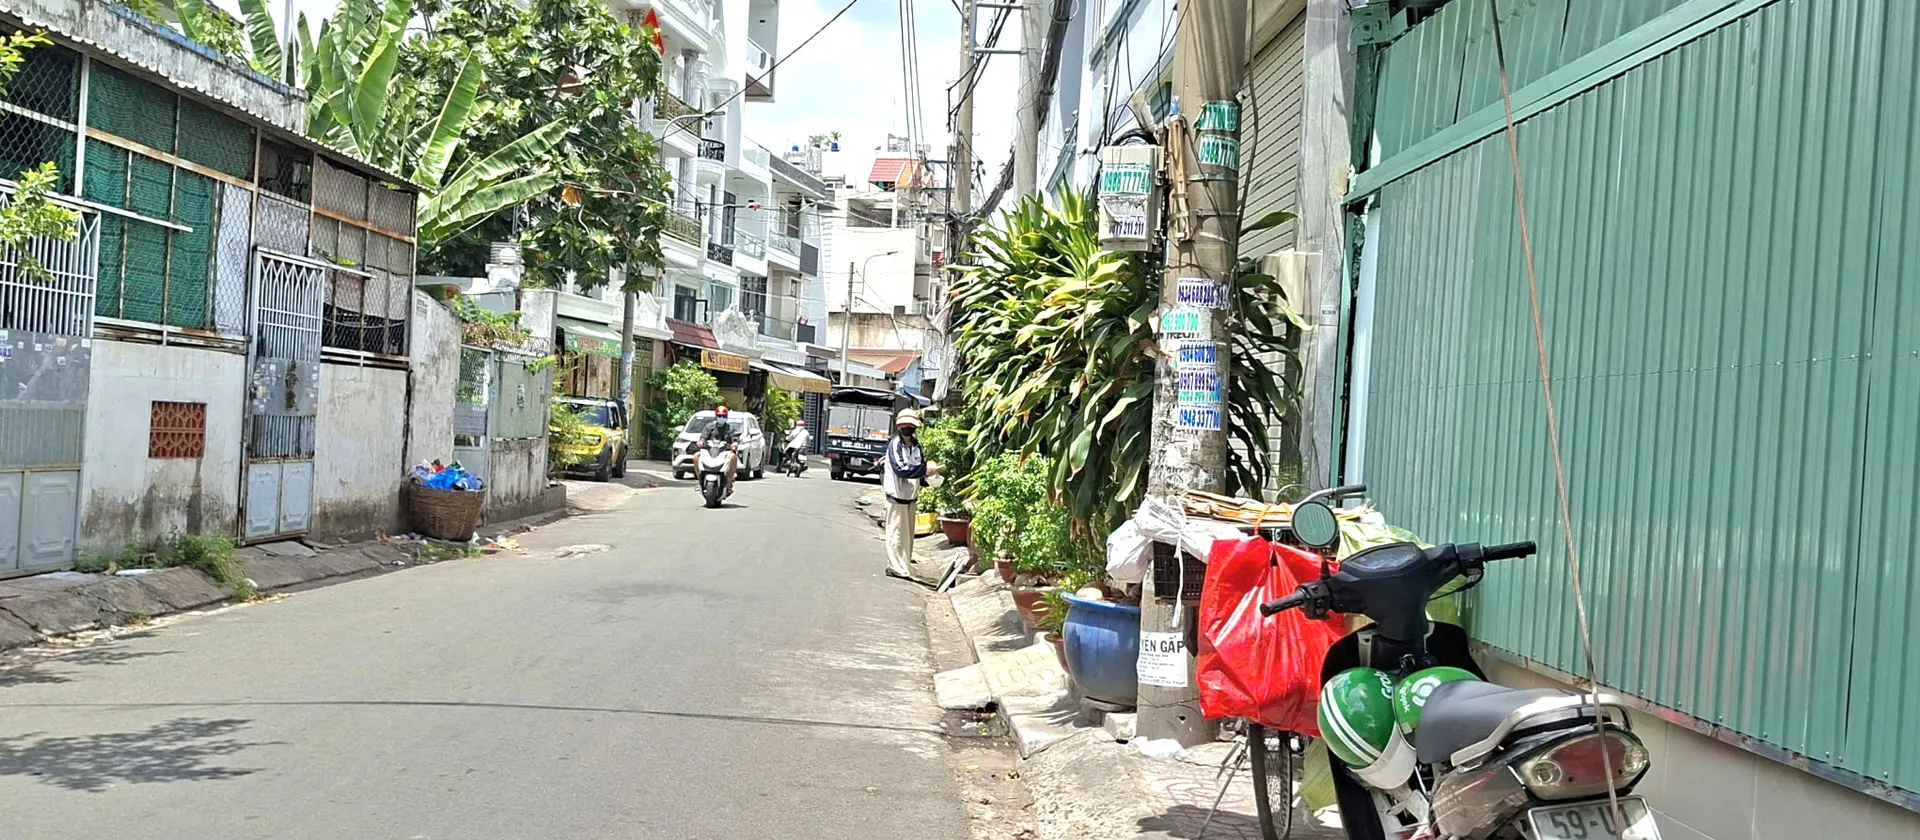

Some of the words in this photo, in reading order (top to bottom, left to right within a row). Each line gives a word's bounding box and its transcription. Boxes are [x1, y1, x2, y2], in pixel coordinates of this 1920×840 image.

[1123, 221, 1133, 235] 211
[1134, 221, 1144, 236] 211
[1160, 635, 1185, 653] GẤP
